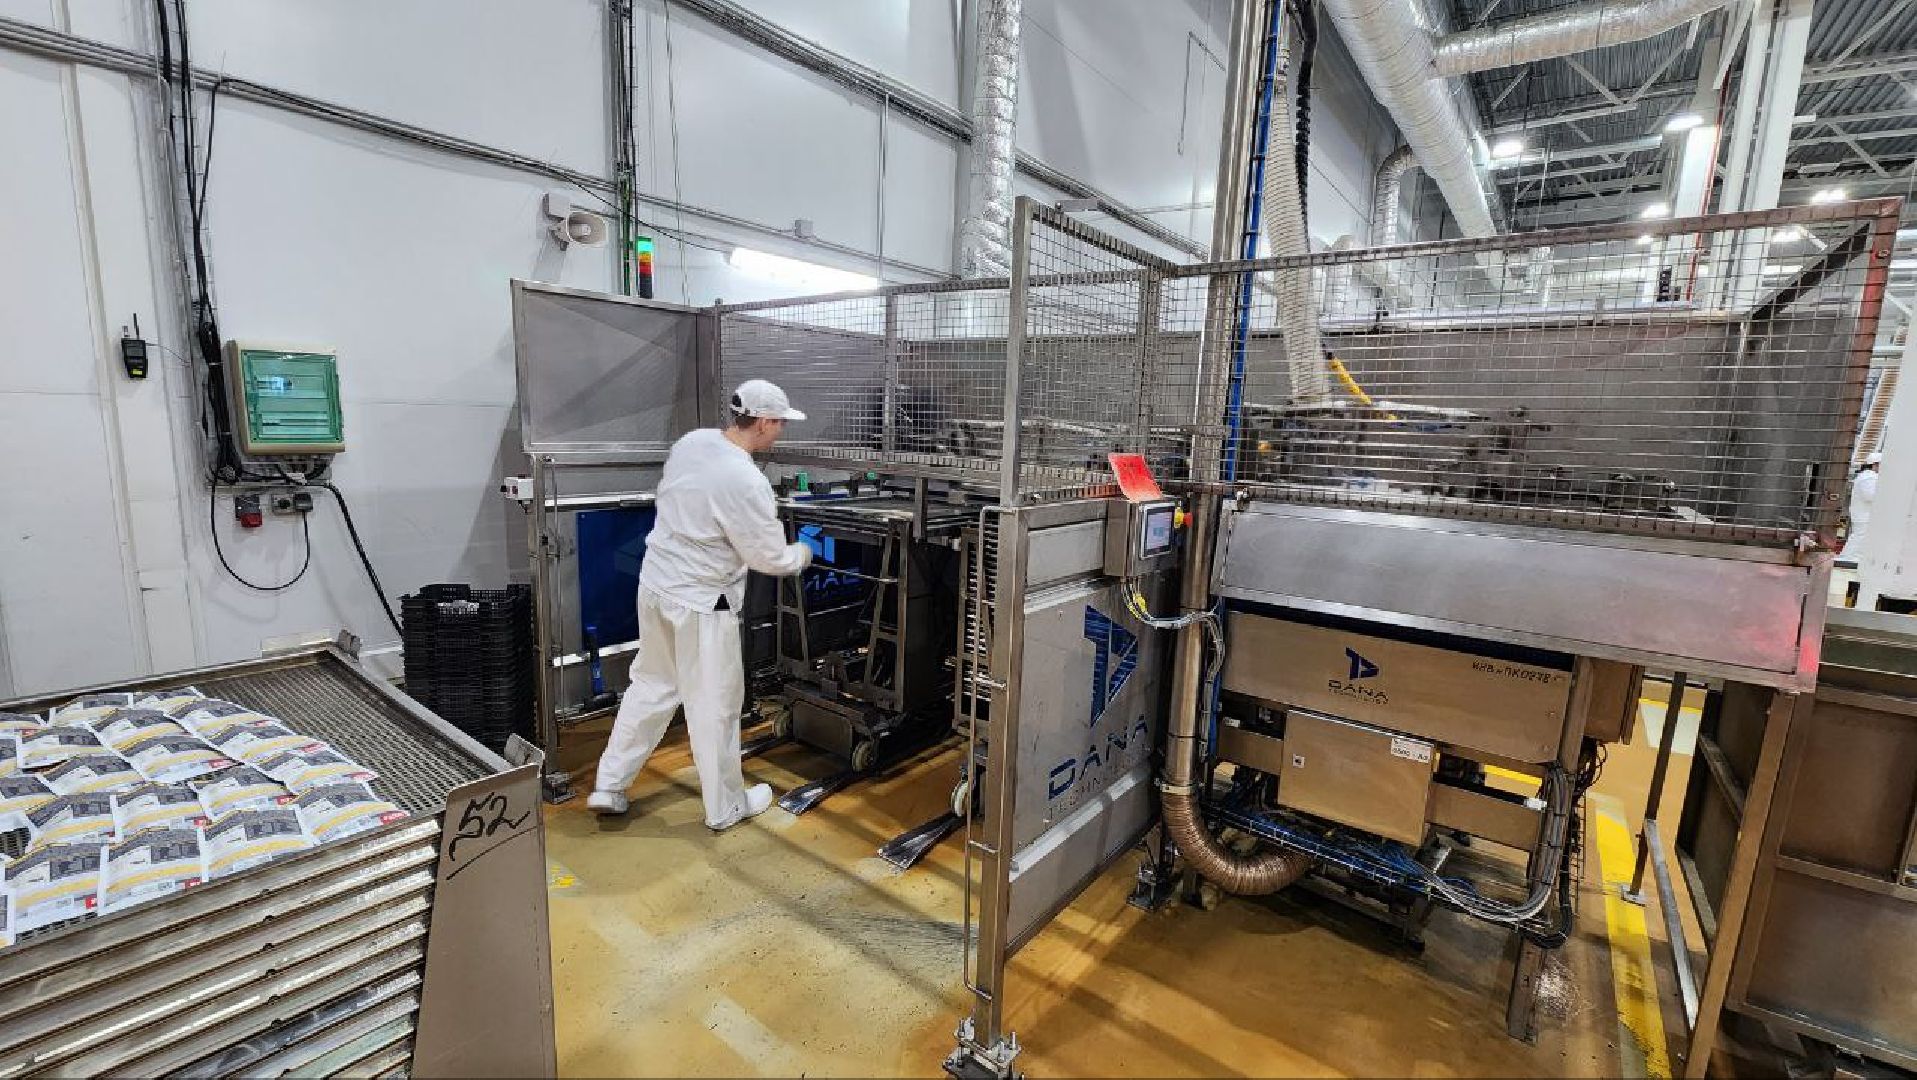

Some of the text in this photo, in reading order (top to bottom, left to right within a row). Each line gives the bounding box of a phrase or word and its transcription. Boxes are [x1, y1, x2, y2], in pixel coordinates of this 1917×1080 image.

[1328, 679, 1387, 701] DANA
[1048, 713, 1147, 800] DANA
[448, 791, 531, 862] 52
